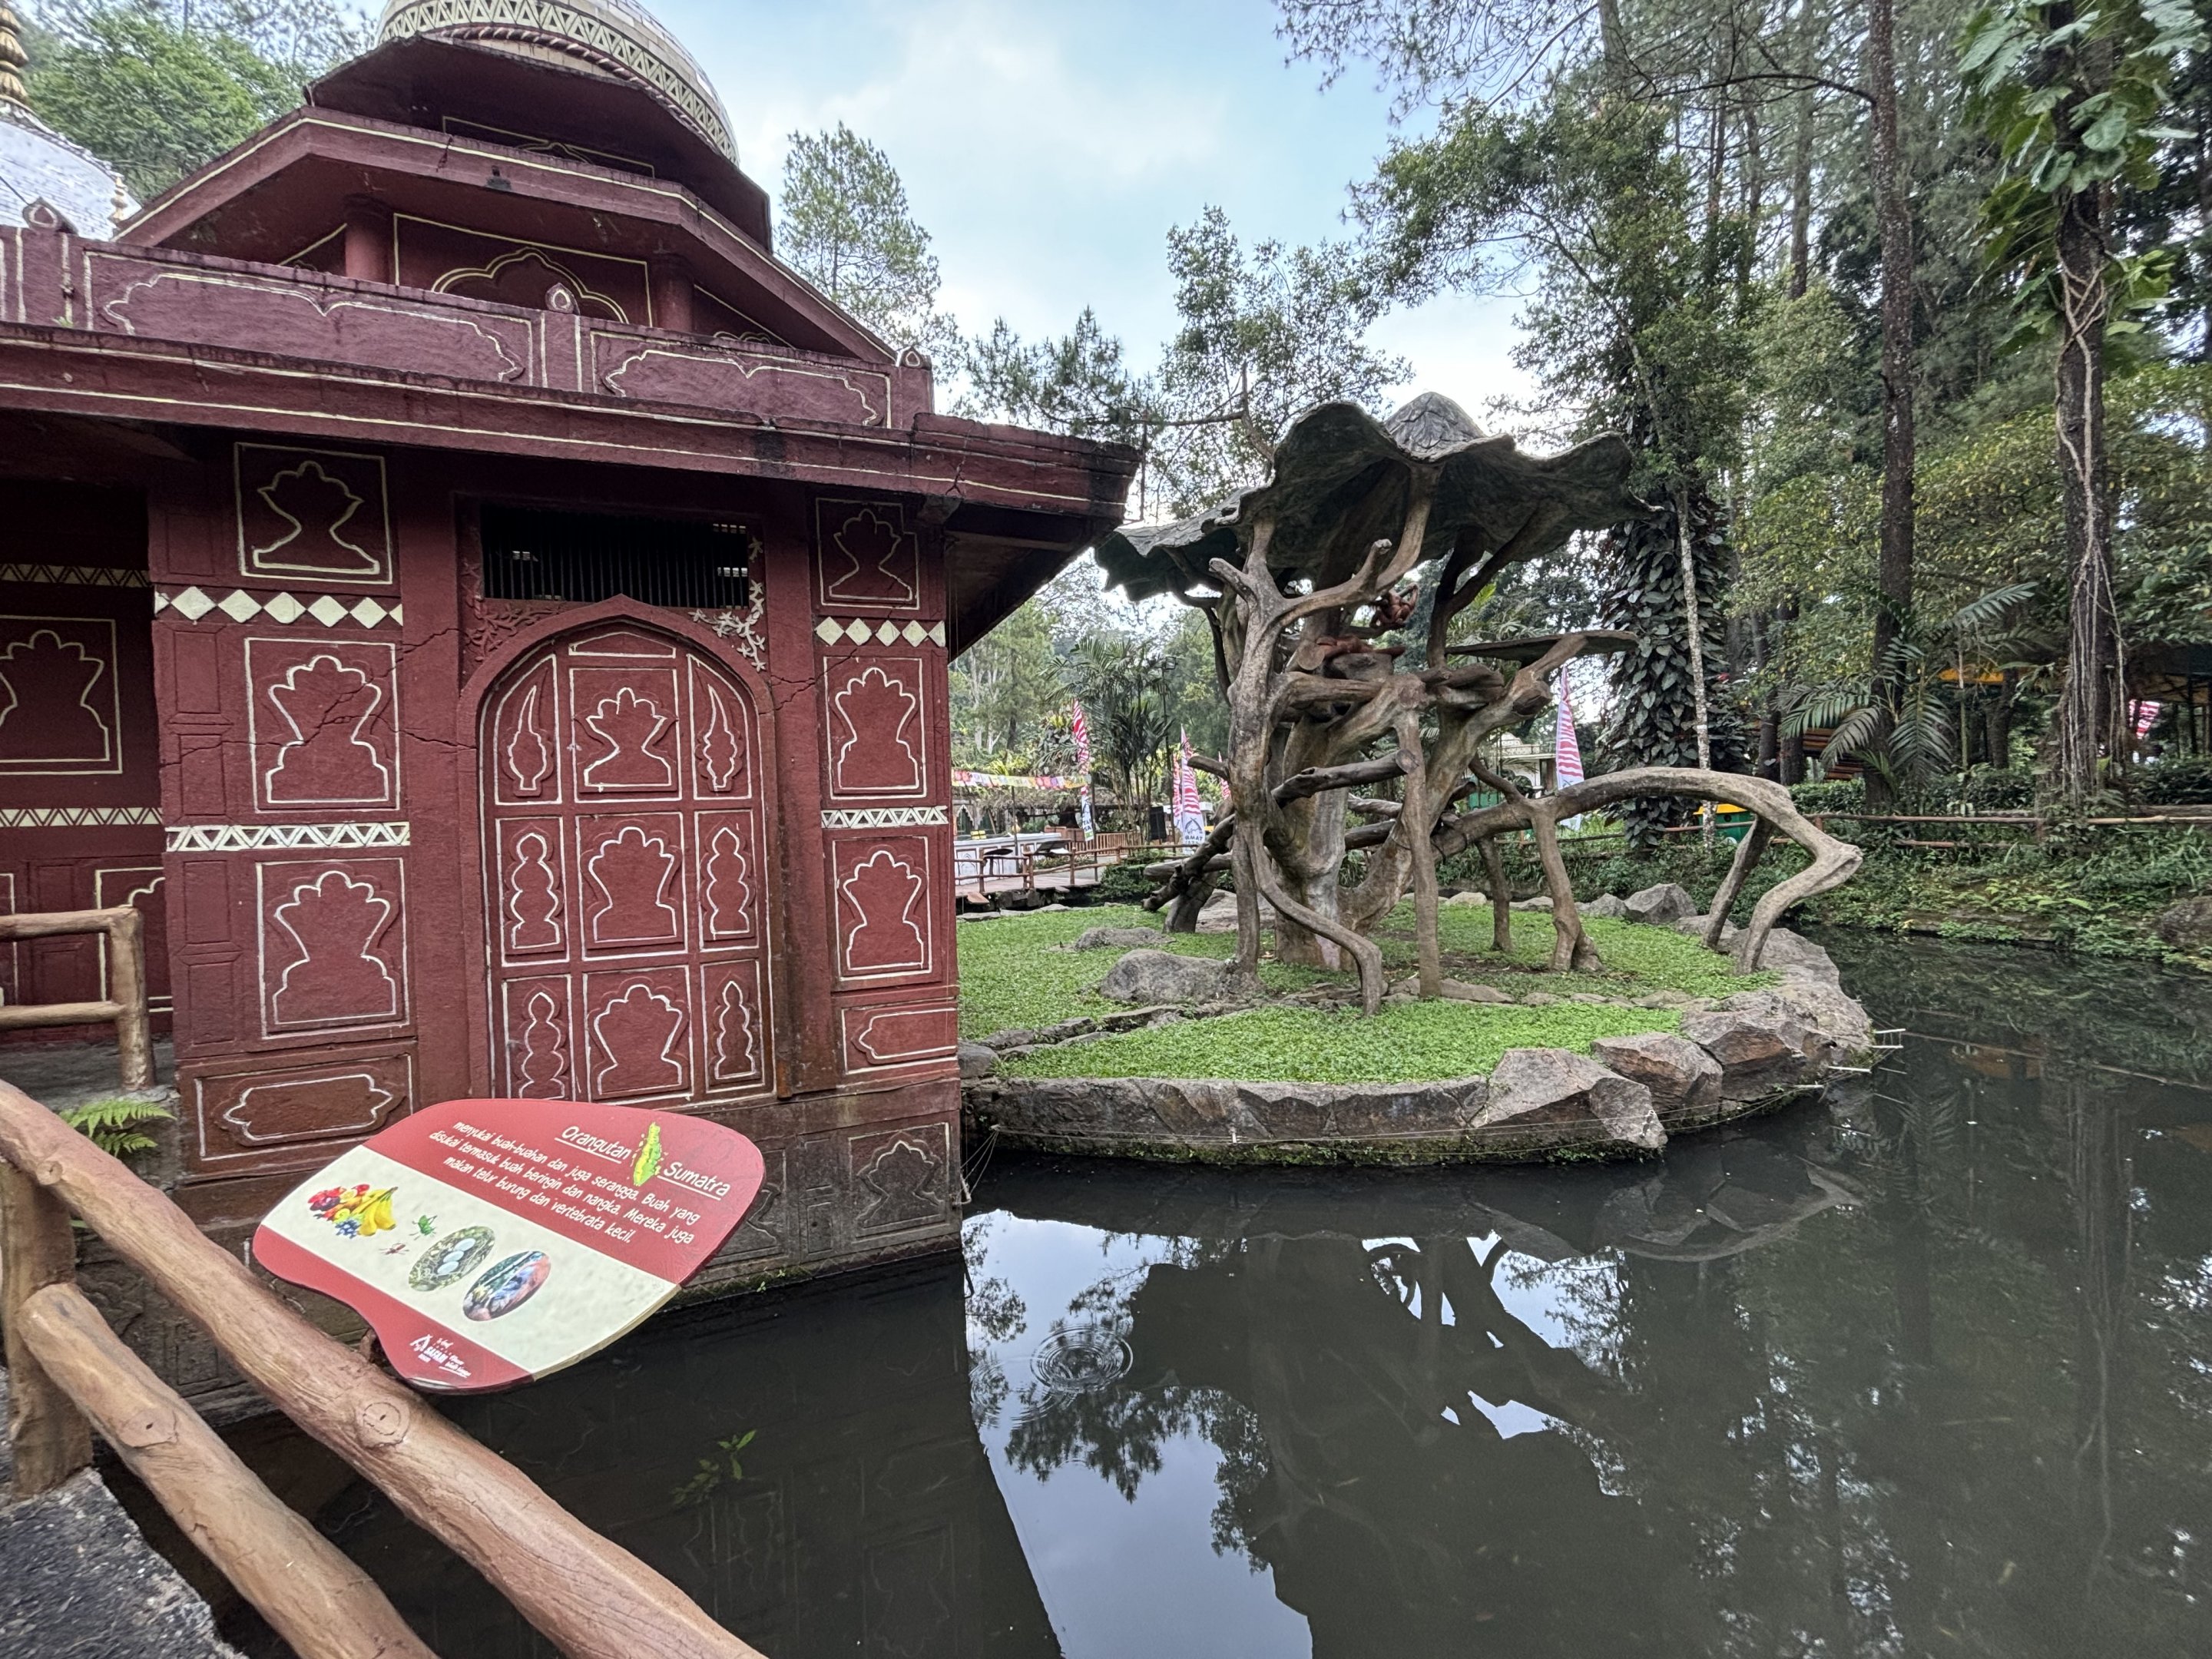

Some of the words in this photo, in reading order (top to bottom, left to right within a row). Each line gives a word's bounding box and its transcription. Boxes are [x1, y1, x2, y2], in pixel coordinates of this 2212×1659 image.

[453, 1122, 496, 1142] menyukai
[492, 1134, 548, 1164] buah-buahan
[547, 1158, 568, 1171] dan
[565, 1166, 592, 1181] juga
[591, 1176, 639, 1200] serangga.
[641, 1194, 671, 1212] Buah
[669, 1207, 700, 1226] yang
[561, 1126, 632, 1161] Orangutan
[664, 1161, 731, 1197] Sumatra
[429, 1131, 462, 1147] disukai
[460, 1142, 502, 1164] termasuk
[499, 1157, 525, 1174] buah
[523, 1167, 562, 1190] beringin
[562, 1185, 583, 1199] dan
[583, 1194, 621, 1215] nangka.
[623, 1207, 667, 1233] Mereka
[664, 1226, 695, 1244] juga
[443, 1157, 475, 1174] makan
[472, 1167, 498, 1183] telur
[495, 1176, 531, 1200] burung
[529, 1192, 551, 1207] dan
[551, 1199, 605, 1230] vertebrata
[604, 1223, 636, 1243] kecil.
